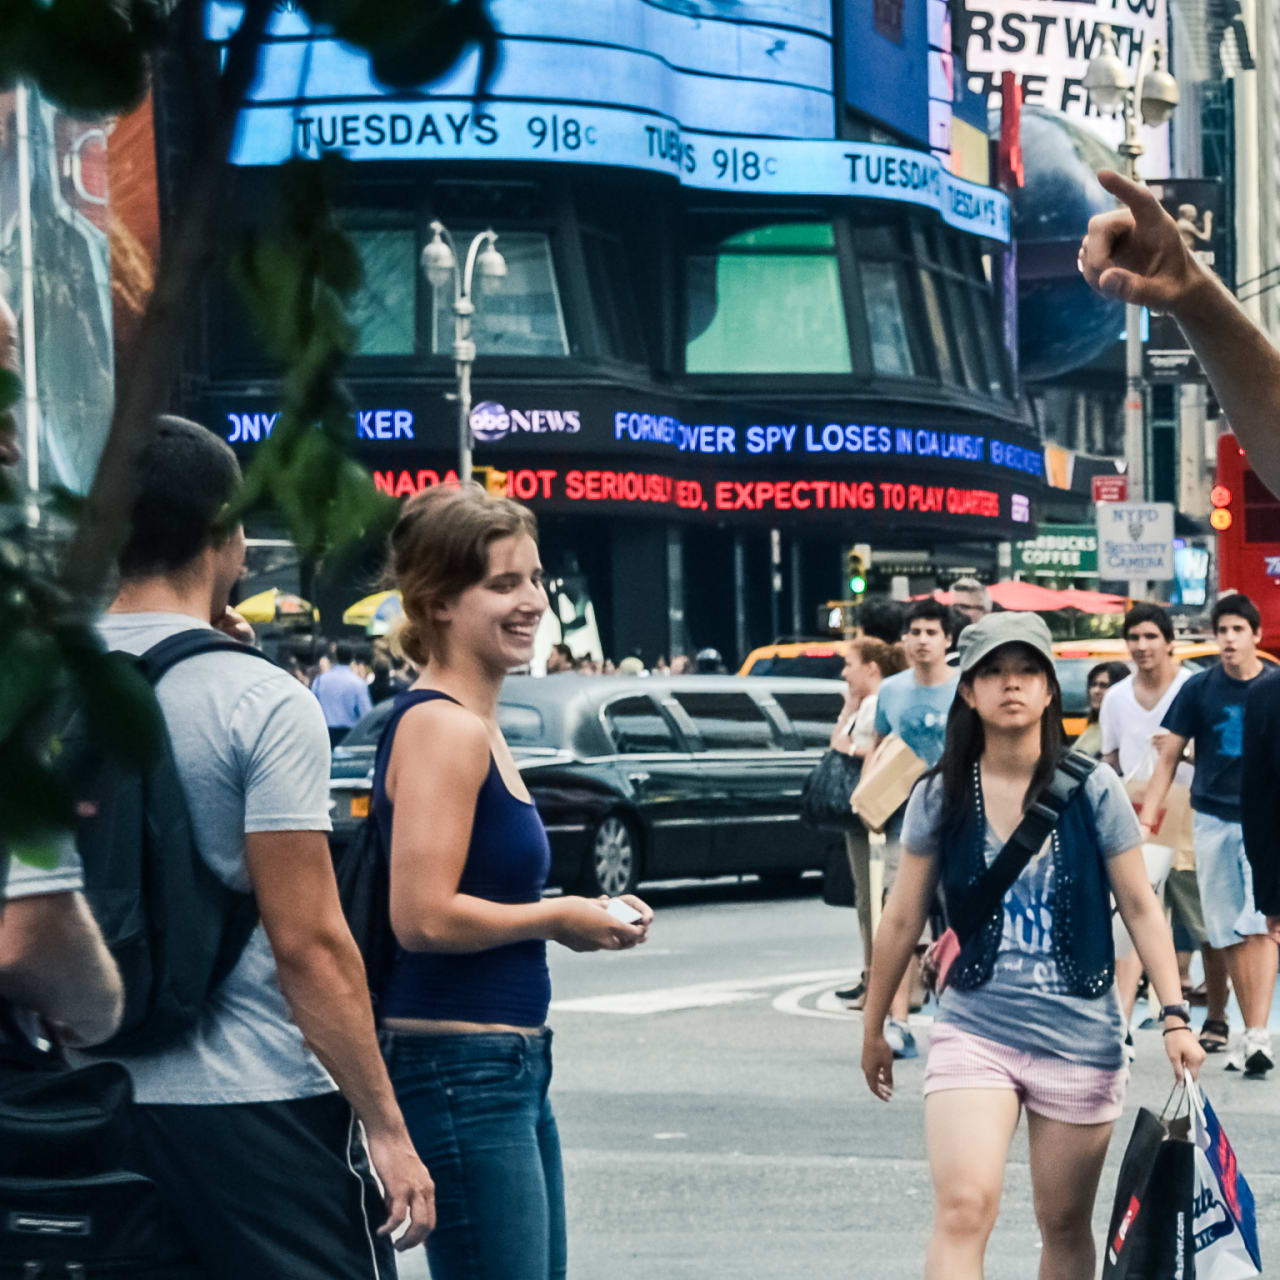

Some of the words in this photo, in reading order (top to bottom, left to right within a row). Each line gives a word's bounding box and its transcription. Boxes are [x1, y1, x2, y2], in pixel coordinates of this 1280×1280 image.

[1064, 17, 1144, 67] WTH
[298, 112, 499, 151] TUESDAYS
[508, 409, 581, 434] NEWS
[745, 424, 798, 454] SPY
[805, 424, 892, 453] LOSES
[895, 427, 913, 454] IN
[714, 480, 876, 511] EXPECTING
[879, 481, 907, 512] TO
[908, 483, 945, 513] PLAY
[1021, 551, 1081, 566] COFFEE
